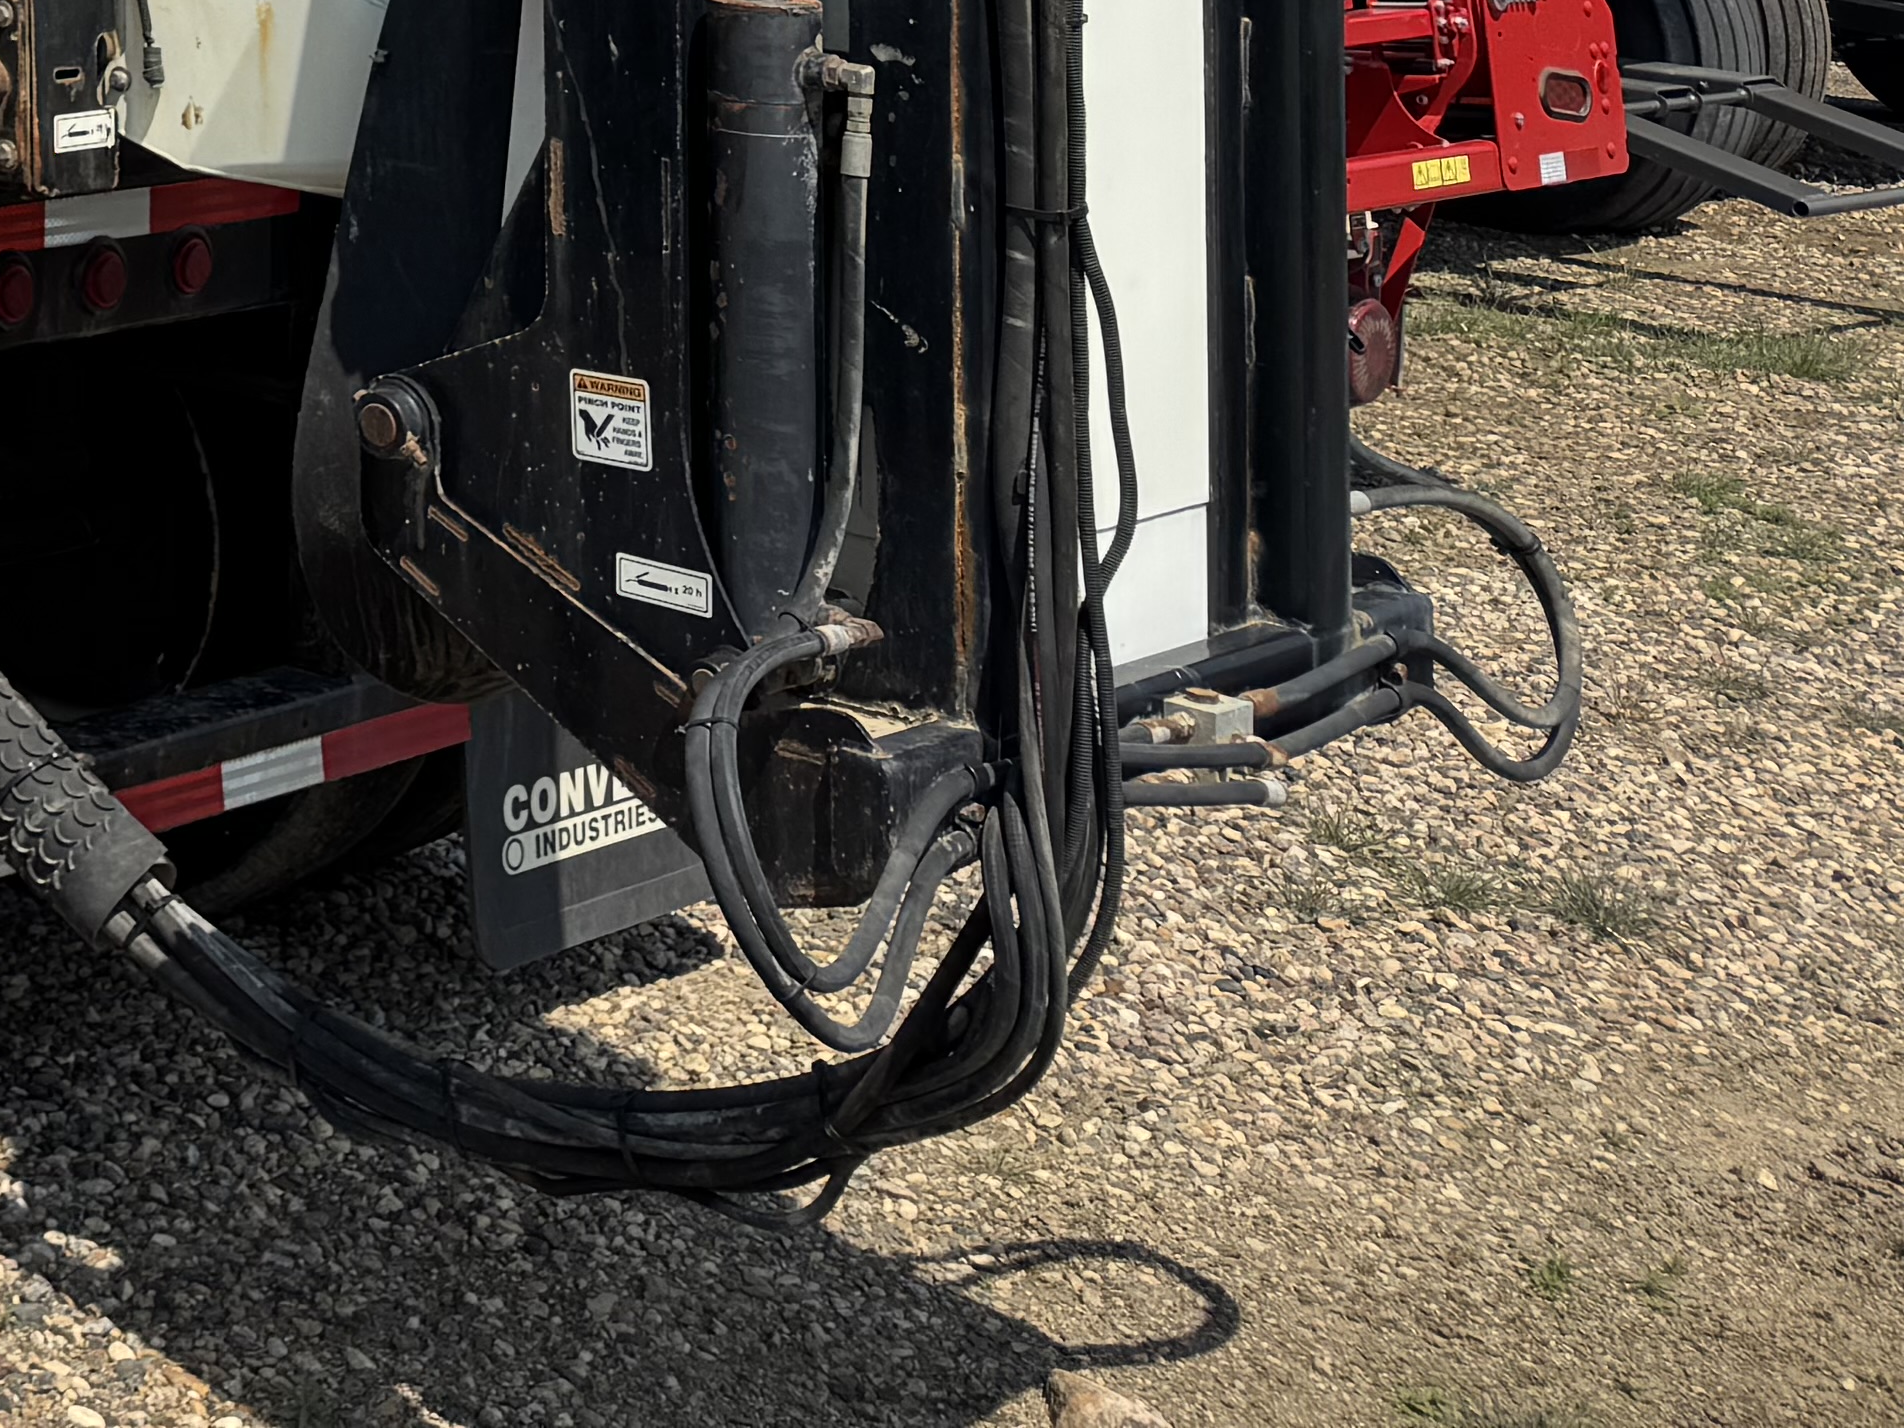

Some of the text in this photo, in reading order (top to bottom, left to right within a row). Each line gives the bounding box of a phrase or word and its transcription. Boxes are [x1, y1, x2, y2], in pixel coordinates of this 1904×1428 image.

[589, 380, 642, 398] WARNING
[578, 395, 641, 414] PINCH POINT
[682, 585, 693, 596] 20
